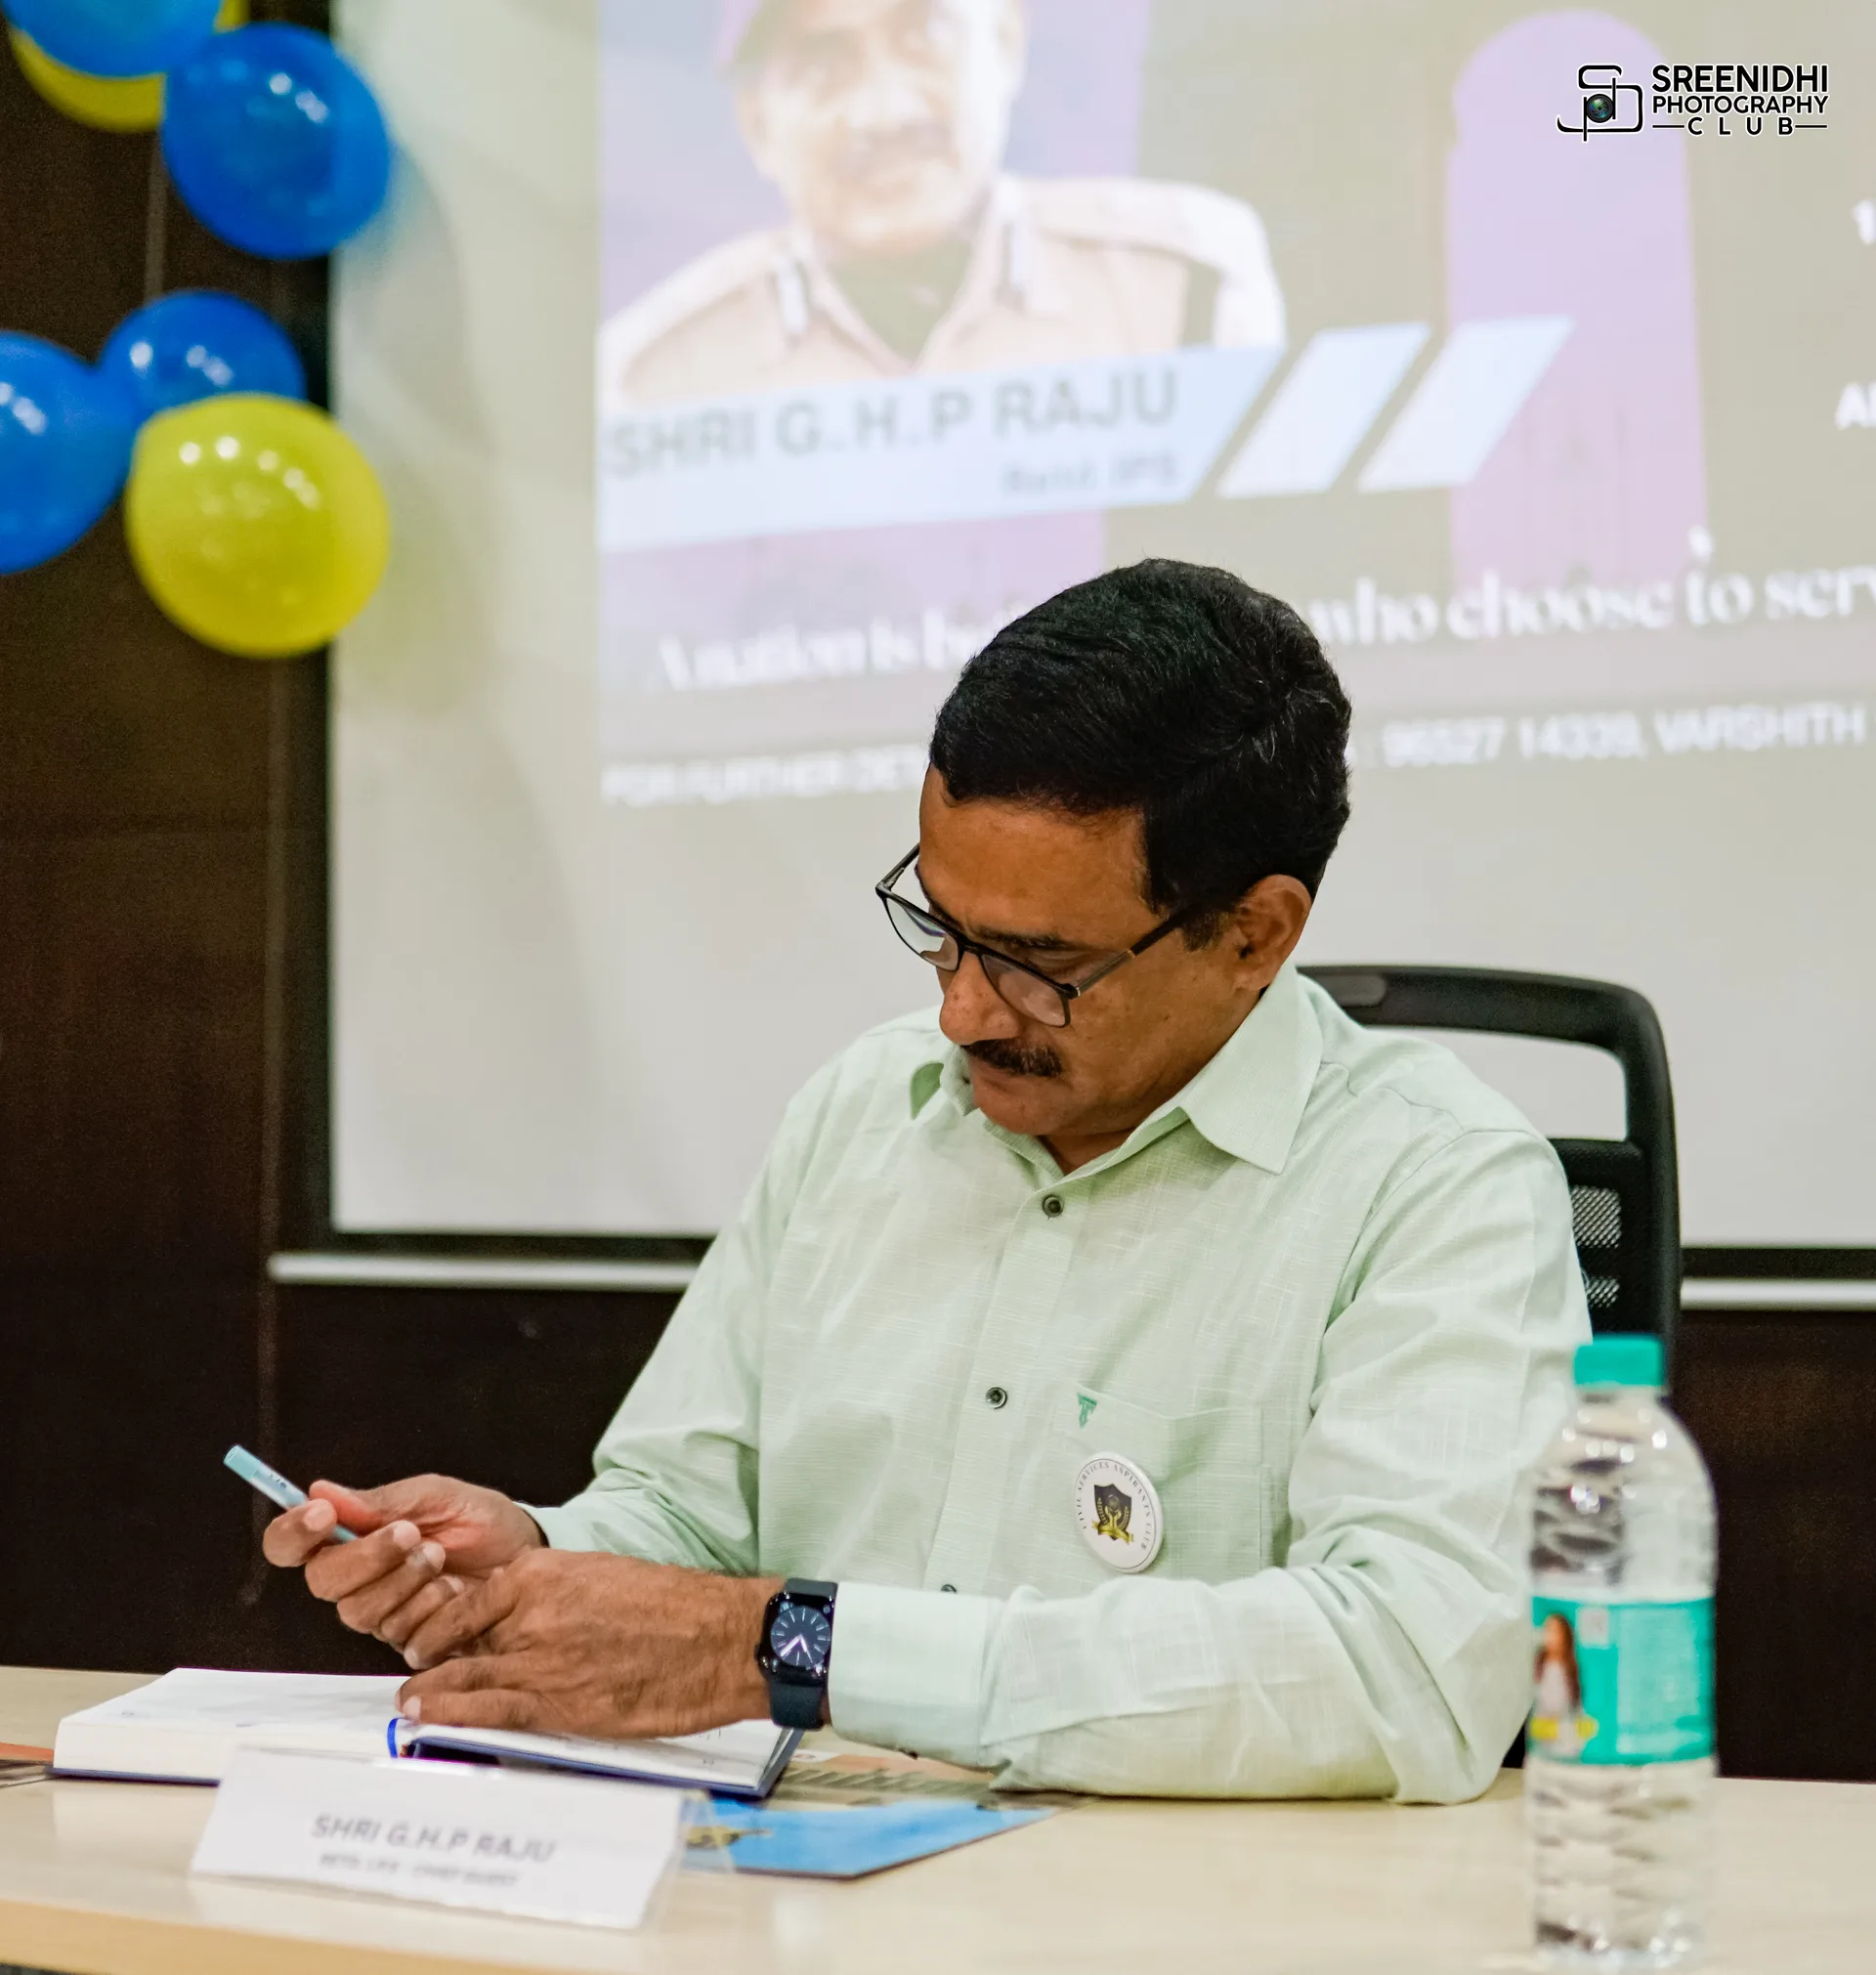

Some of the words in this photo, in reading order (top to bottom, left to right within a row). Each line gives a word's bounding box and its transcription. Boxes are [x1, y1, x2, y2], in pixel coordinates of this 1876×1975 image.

[607, 404, 757, 478] SHRI
[993, 367, 1179, 437] RAJU
[1447, 568, 1674, 638] choose
[1684, 570, 1755, 627] to
[1078, 1462, 1110, 1491] SERVICES
[311, 1814, 382, 1845] SHRI
[473, 1830, 558, 1865] RAJU
